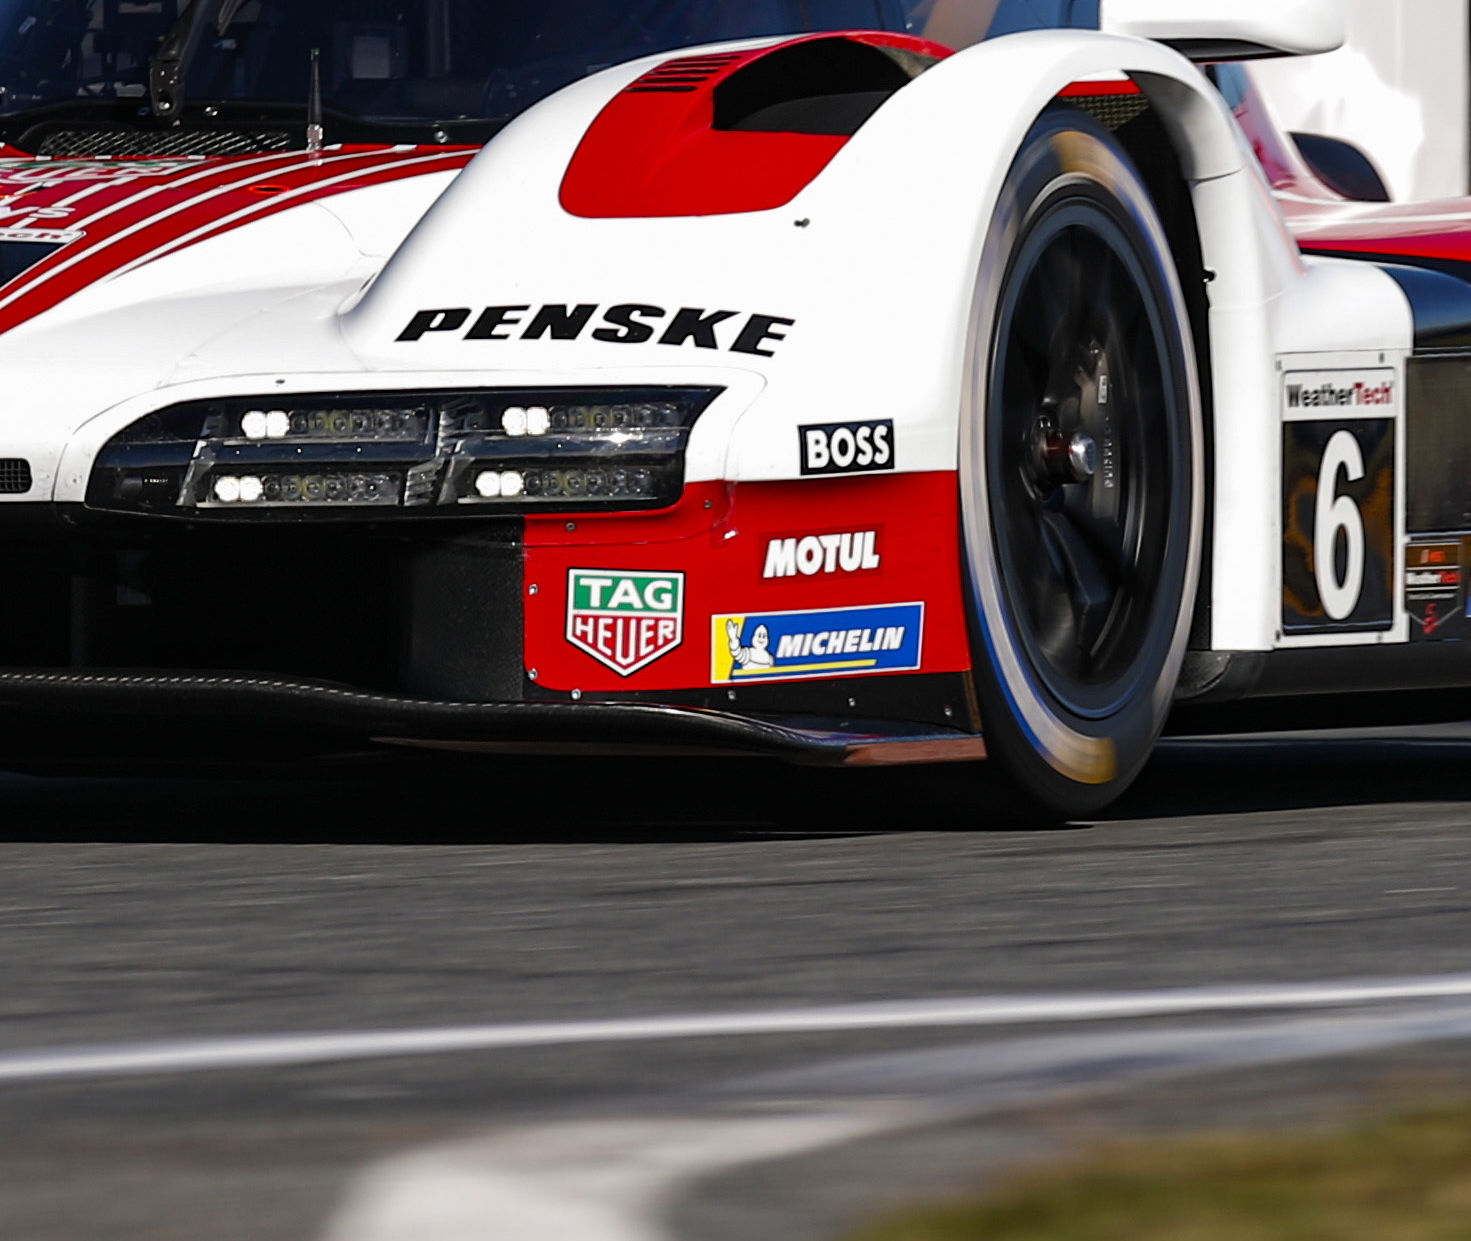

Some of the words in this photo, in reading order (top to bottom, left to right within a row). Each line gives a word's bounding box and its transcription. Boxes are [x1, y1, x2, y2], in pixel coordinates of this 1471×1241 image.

[394, 303, 796, 357] PENSKE
[1286, 382, 1393, 408] WeatherTech
[805, 424, 891, 470] BOSS
[1313, 429, 1366, 621] 6
[763, 531, 880, 578] MOTUL
[579, 577, 674, 610] TAG
[575, 616, 676, 668] HEUER
[775, 625, 906, 659] MICHELIN
